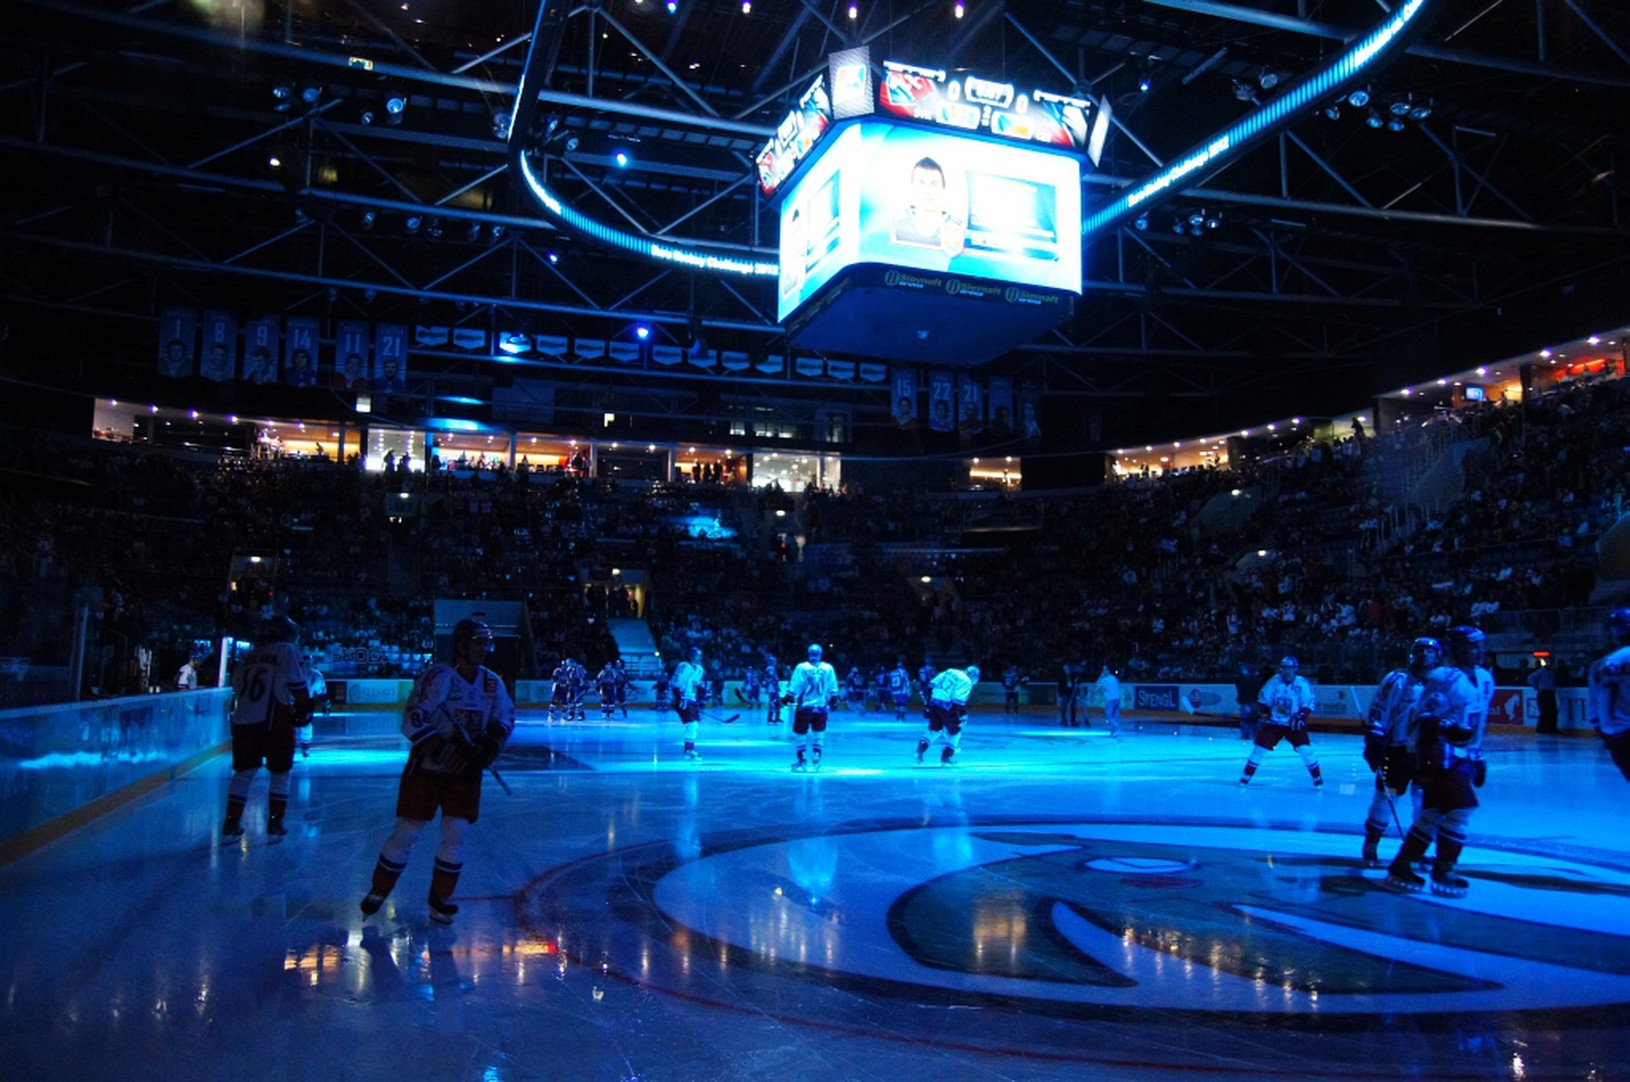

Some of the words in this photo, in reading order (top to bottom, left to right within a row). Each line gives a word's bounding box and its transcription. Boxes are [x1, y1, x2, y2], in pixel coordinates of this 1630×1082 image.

[214, 322, 226, 343] 8
[256, 325, 268, 347] 9
[293, 328, 311, 350] 14
[345, 333, 361, 354] 11
[382, 336, 401, 358] 21
[896, 378, 911, 397] 15
[932, 382, 951, 400] 22
[963, 384, 978, 402] 21
